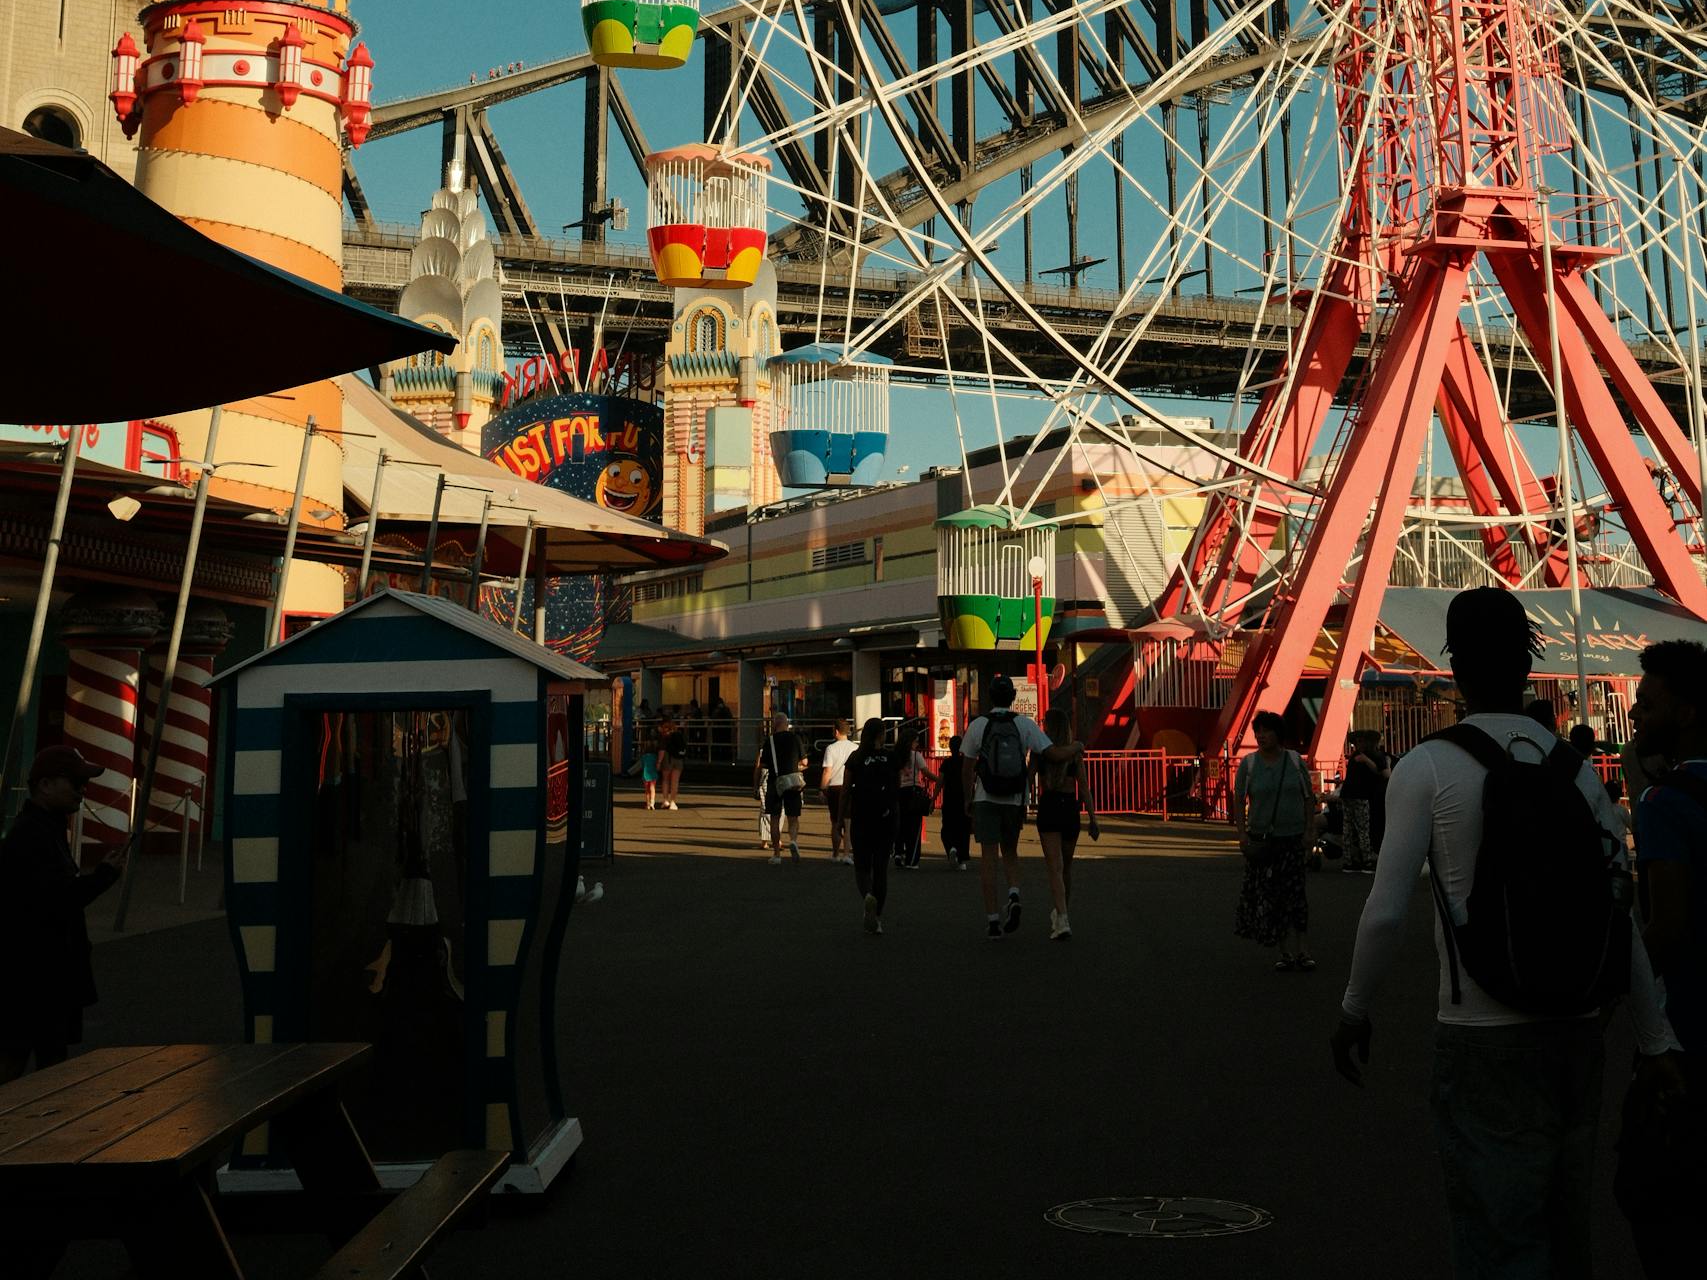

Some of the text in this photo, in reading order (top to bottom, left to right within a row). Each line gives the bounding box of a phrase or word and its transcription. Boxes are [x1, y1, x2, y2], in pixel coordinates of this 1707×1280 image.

[495, 416, 643, 480] UST FOR FU
[1559, 652, 1611, 662] Syney
[1014, 703, 1037, 712] RGERS
